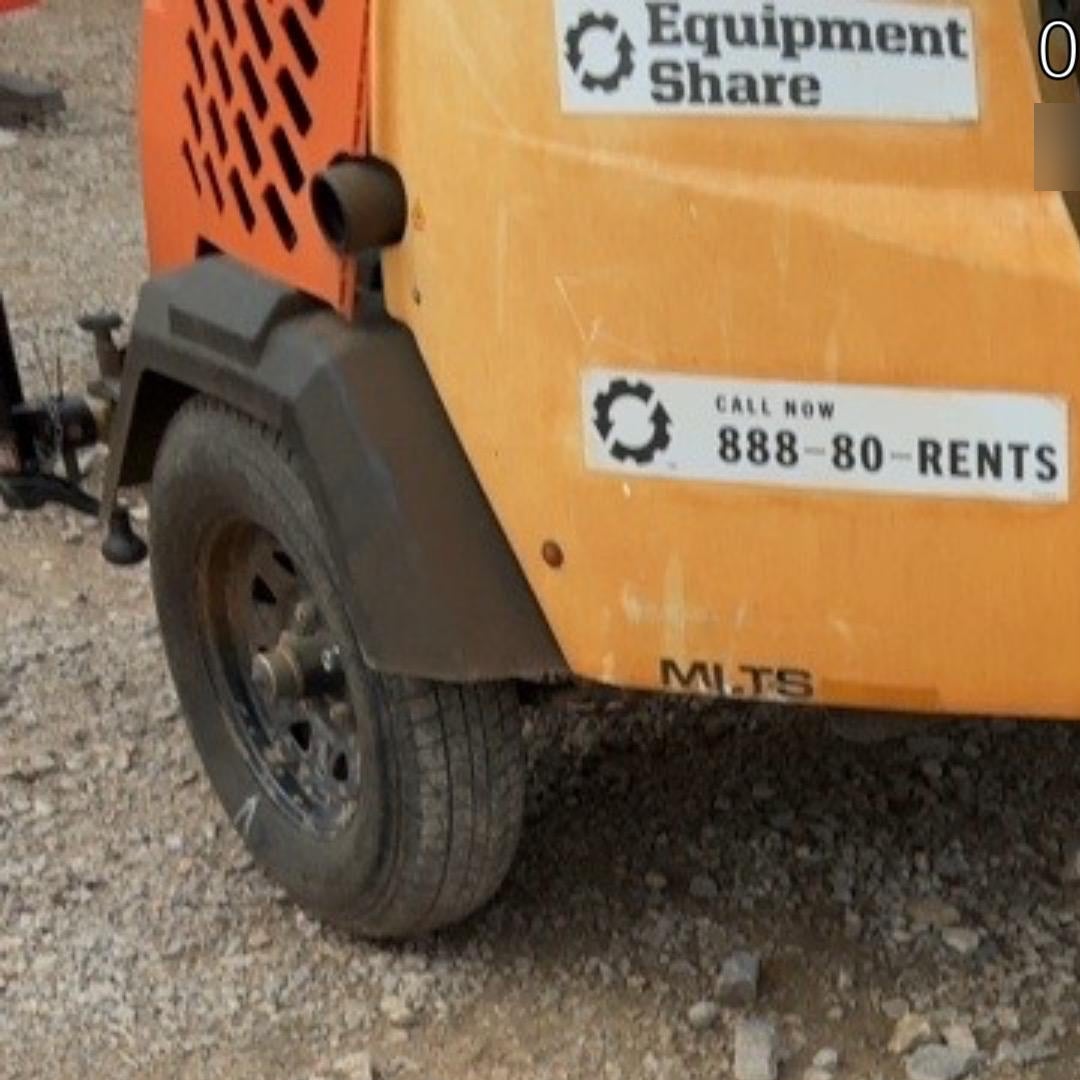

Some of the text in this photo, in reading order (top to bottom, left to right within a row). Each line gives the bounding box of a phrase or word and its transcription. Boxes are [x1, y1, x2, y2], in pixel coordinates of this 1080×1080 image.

[645, 1, 969, 59] Equipment
[649, 60, 822, 108] Share
[715, 394, 835, 421] CALL NOW
